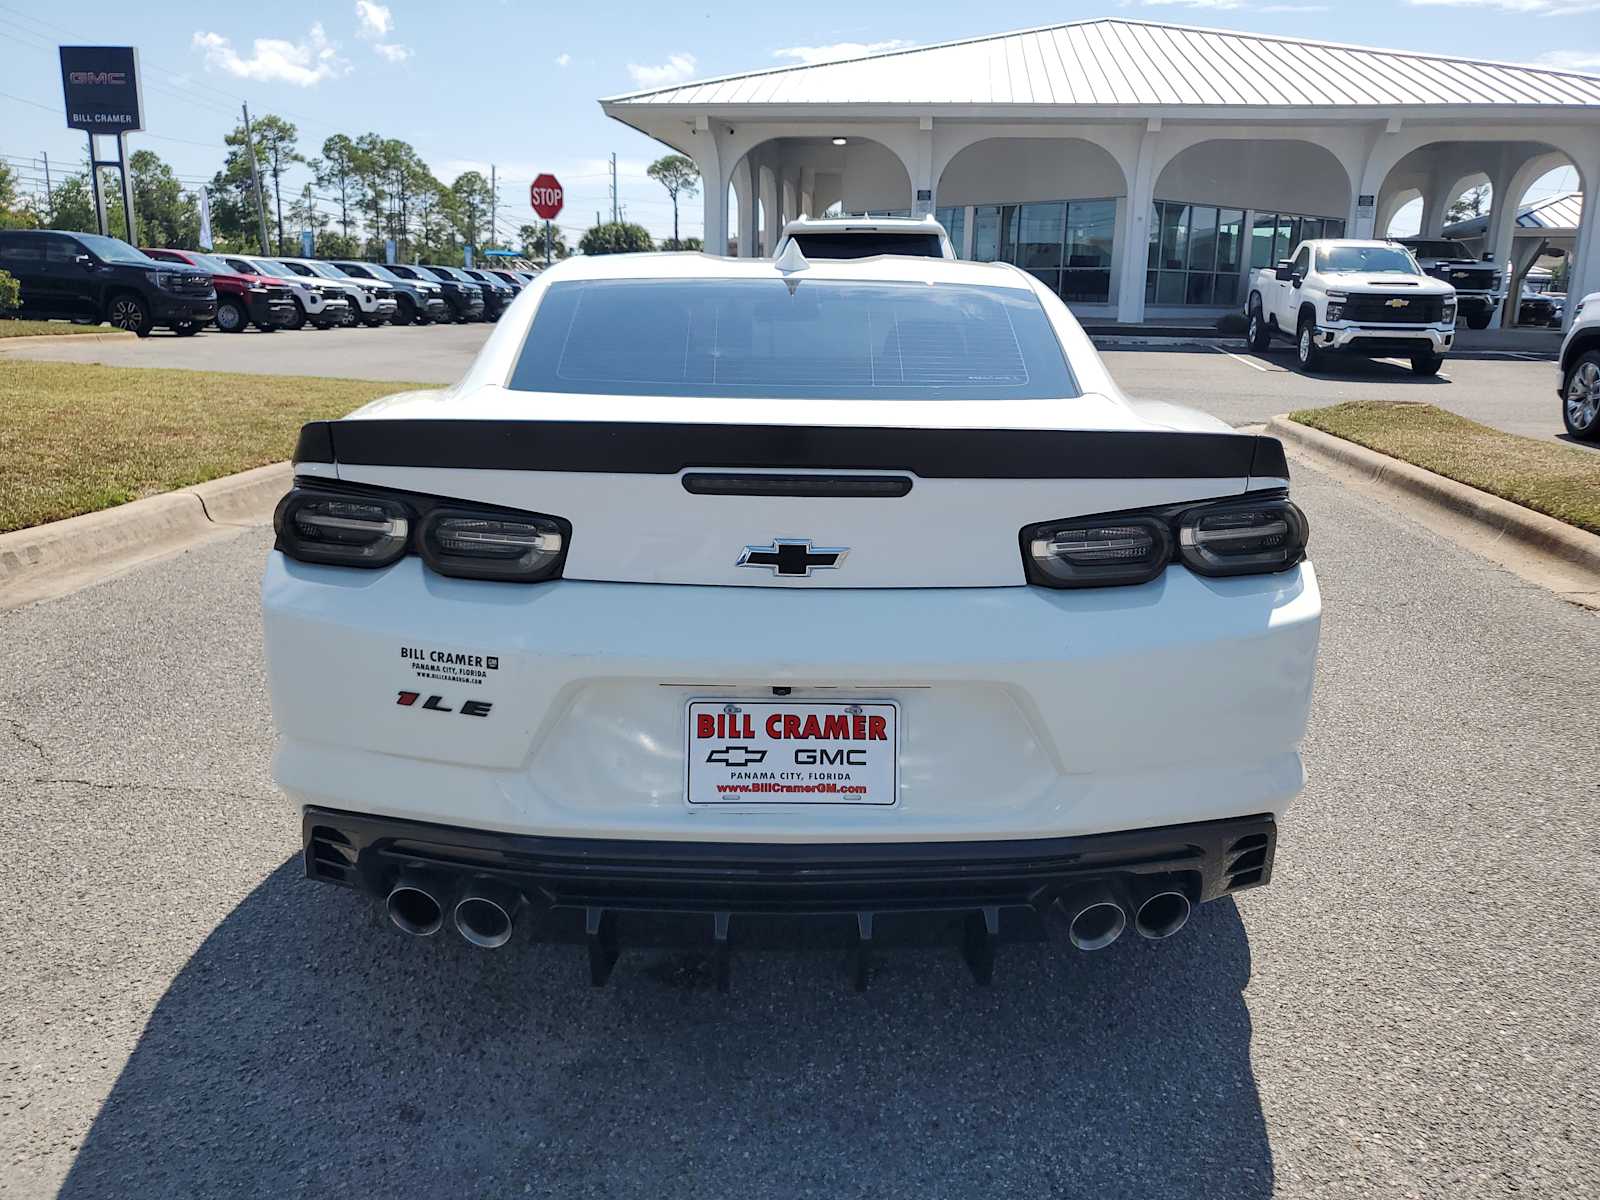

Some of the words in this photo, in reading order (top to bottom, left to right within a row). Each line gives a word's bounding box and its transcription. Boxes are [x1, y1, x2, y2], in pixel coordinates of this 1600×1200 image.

[70, 72, 127, 84] GMC
[73, 113, 92, 122] BILL
[94, 114, 132, 123] CRAMER
[532, 187, 562, 206] STOP
[401, 647, 425, 660] BILL
[430, 650, 483, 667] CRAMER
[412, 662, 440, 672] PANAMA
[442, 666, 458, 675] CITY,
[459, 668, 487, 678] FLORIDA
[397, 691, 493, 717] 1LE
[697, 714, 755, 739] BILL
[765, 714, 888, 741] CRAMER
[794, 749, 867, 766] GMC
[731, 772, 775, 780] PANAMA
[780, 772, 805, 781] CITY,
[808, 773, 851, 781] FLORIDA
[717, 783, 867, 794] www.BillCramerGM.com
